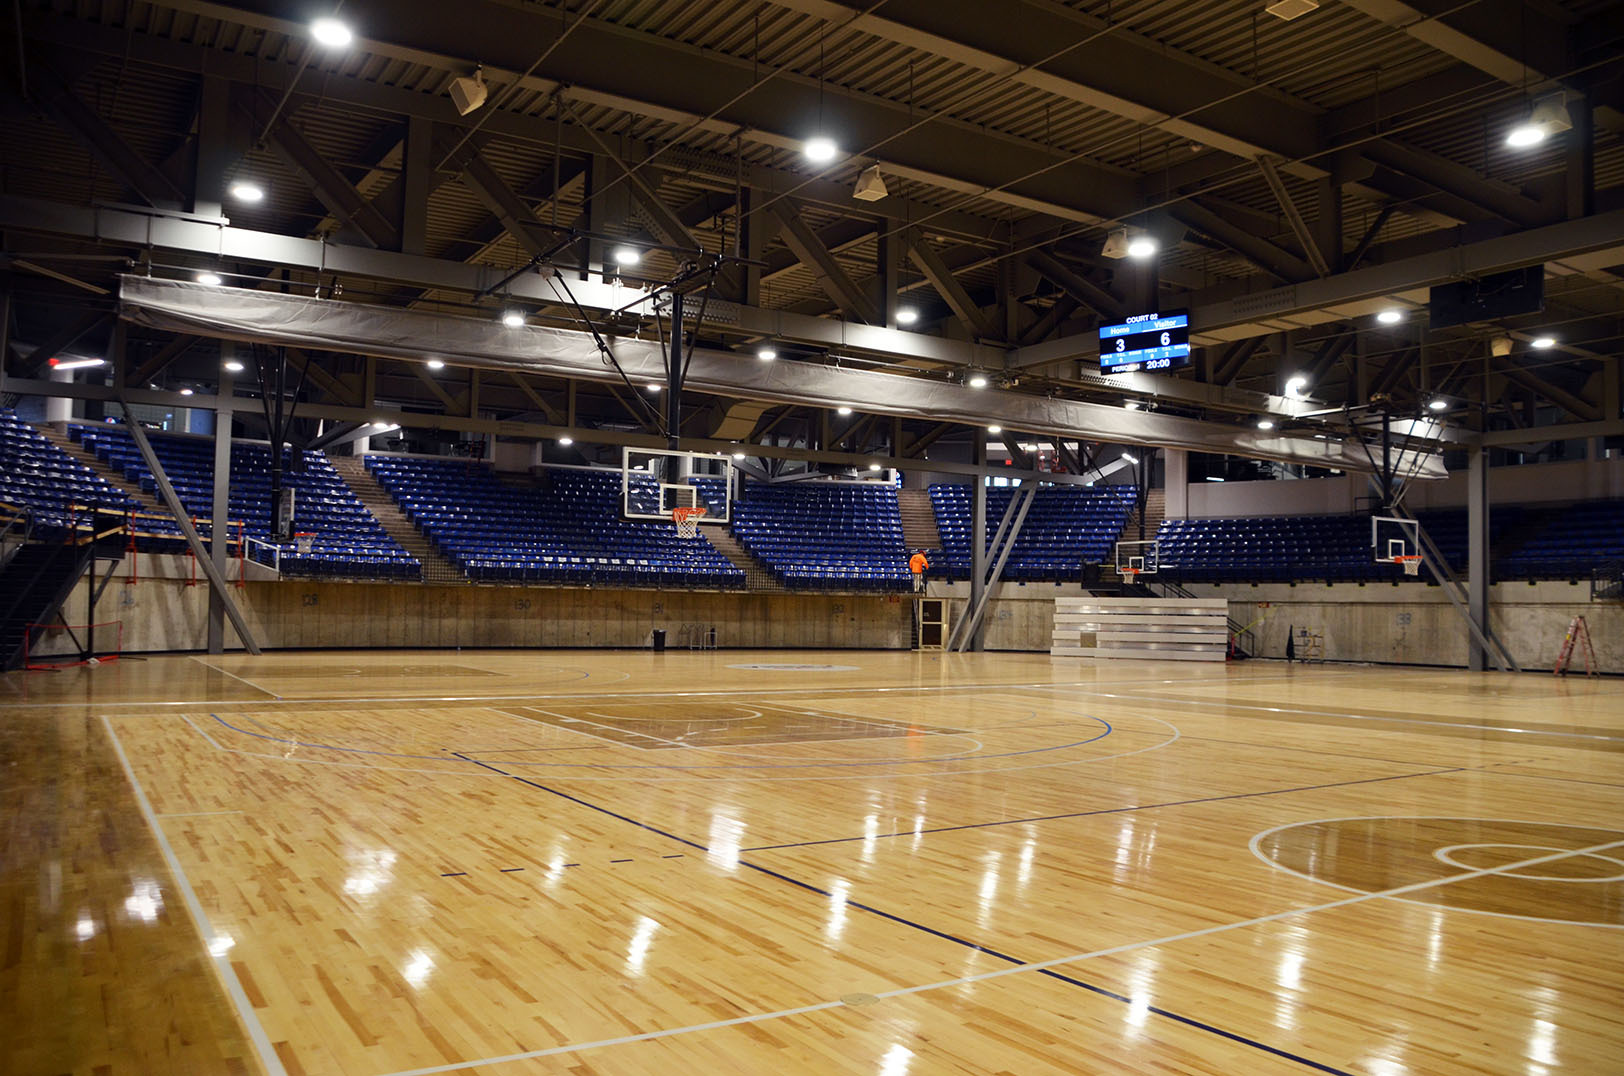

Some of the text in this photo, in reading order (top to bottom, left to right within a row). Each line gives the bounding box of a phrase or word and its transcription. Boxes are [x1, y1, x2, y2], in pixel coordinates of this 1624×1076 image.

[1126, 315, 1149, 324] COURT
[1154, 320, 1177, 328] Visitor
[1110, 327, 1130, 336] Home
[1160, 332, 1171, 346] 6
[1116, 339, 1125, 352] 3
[1112, 363, 1133, 373] PERIO
[1146, 358, 1170, 369] 20:00
